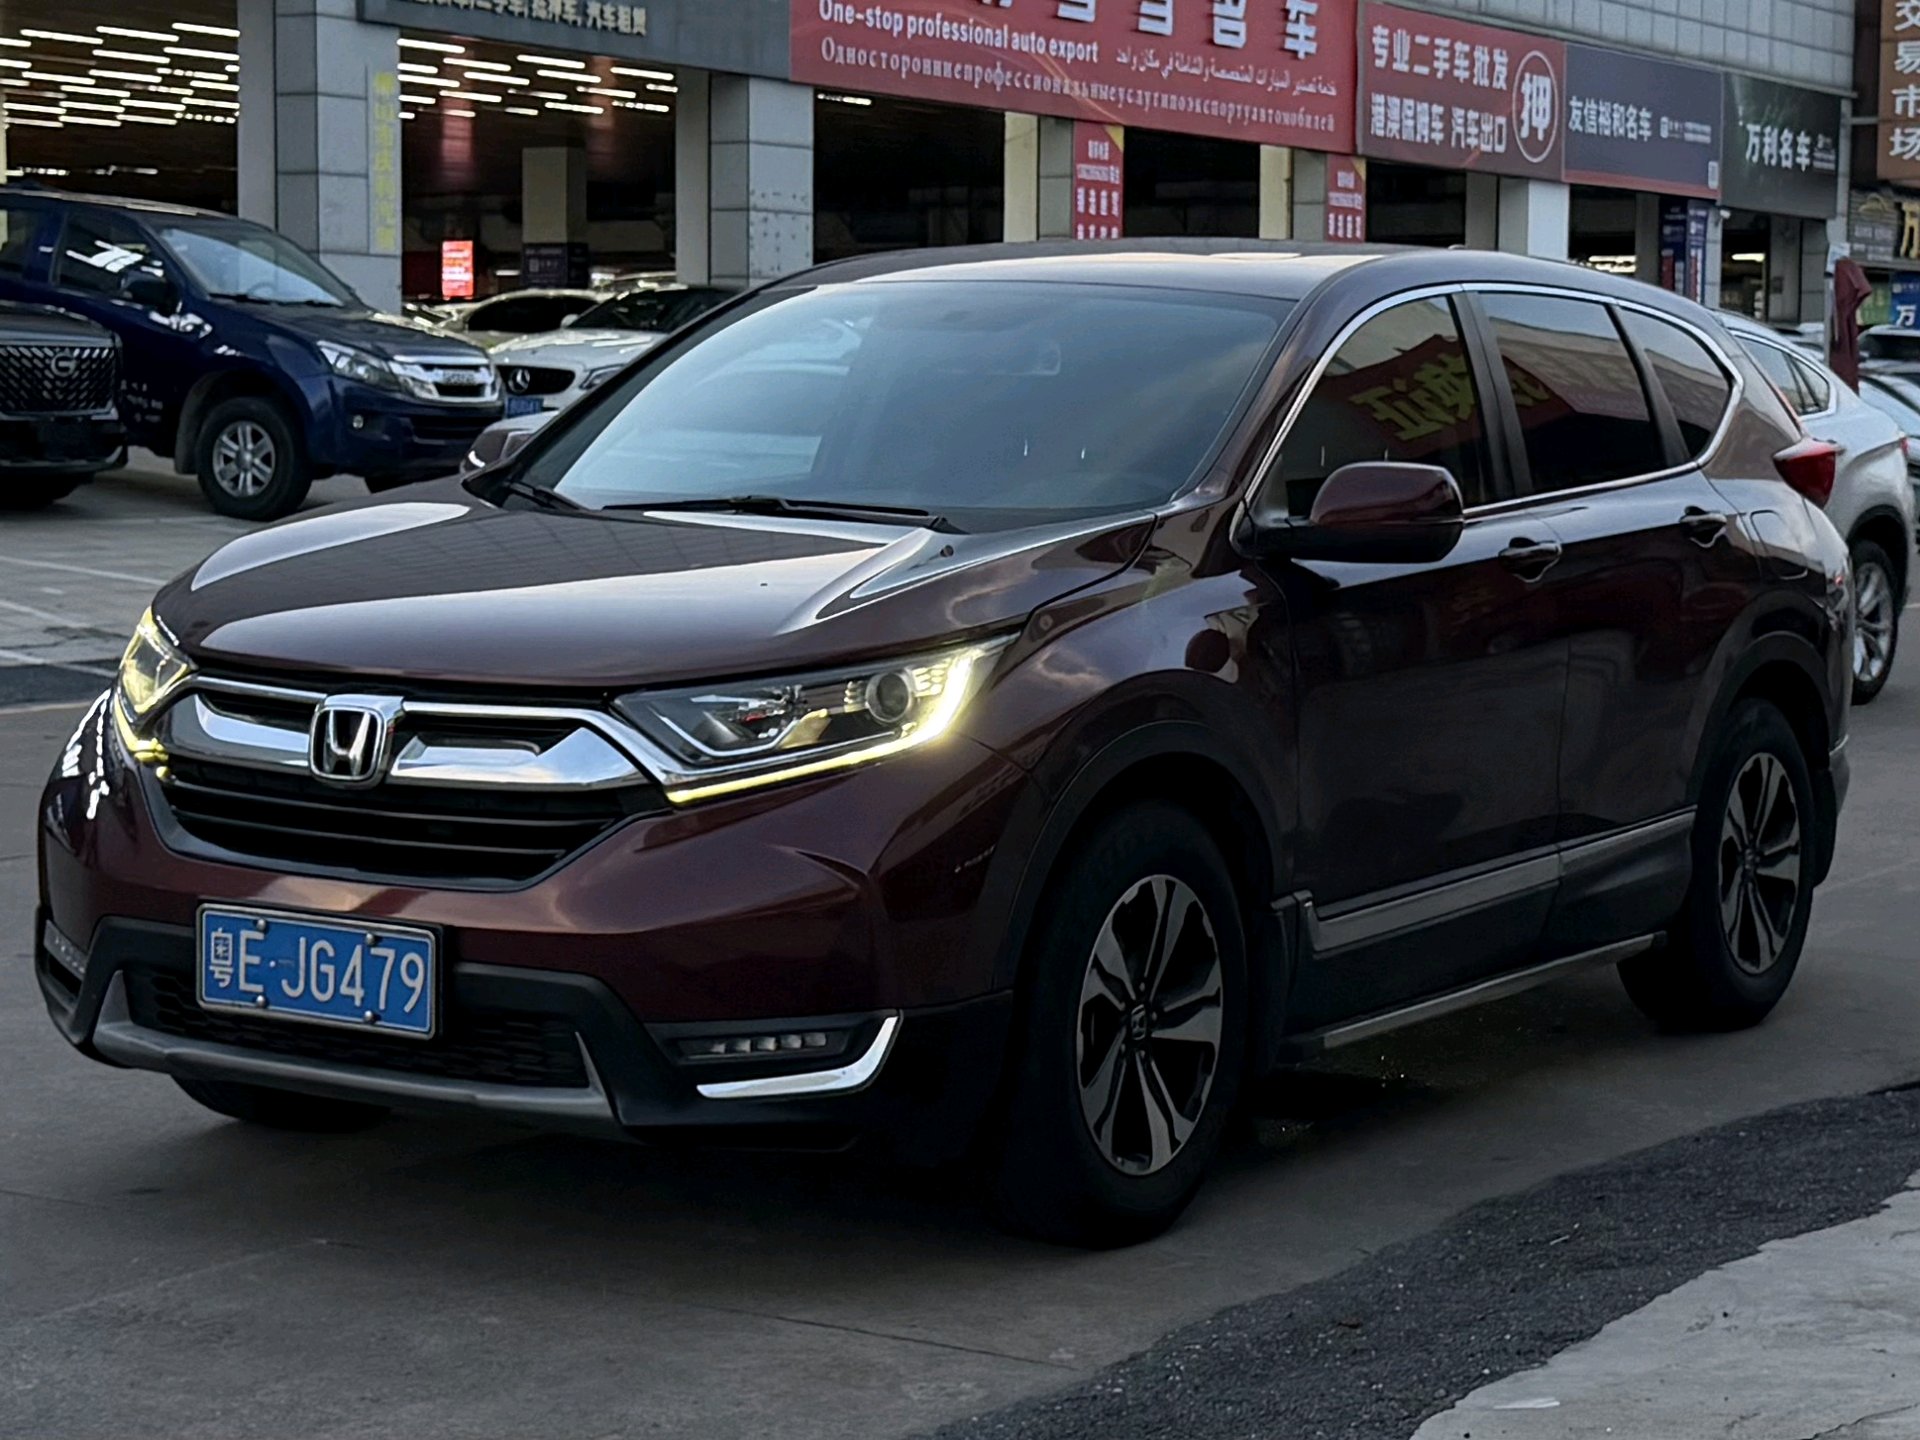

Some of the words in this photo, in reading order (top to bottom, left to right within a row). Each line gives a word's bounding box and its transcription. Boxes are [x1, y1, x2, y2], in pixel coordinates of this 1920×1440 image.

[819, 0, 904, 38] One-stop
[907, 12, 1008, 49] professional
[1011, 31, 1046, 54] auto
[1048, 36, 1098, 64] export
[1372, 24, 1508, 91] 专业二手车批发
[1451, 106, 1507, 154] 汽车出口
[1520, 72, 1551, 141] 押
[1745, 122, 1811, 171] 万利名车
